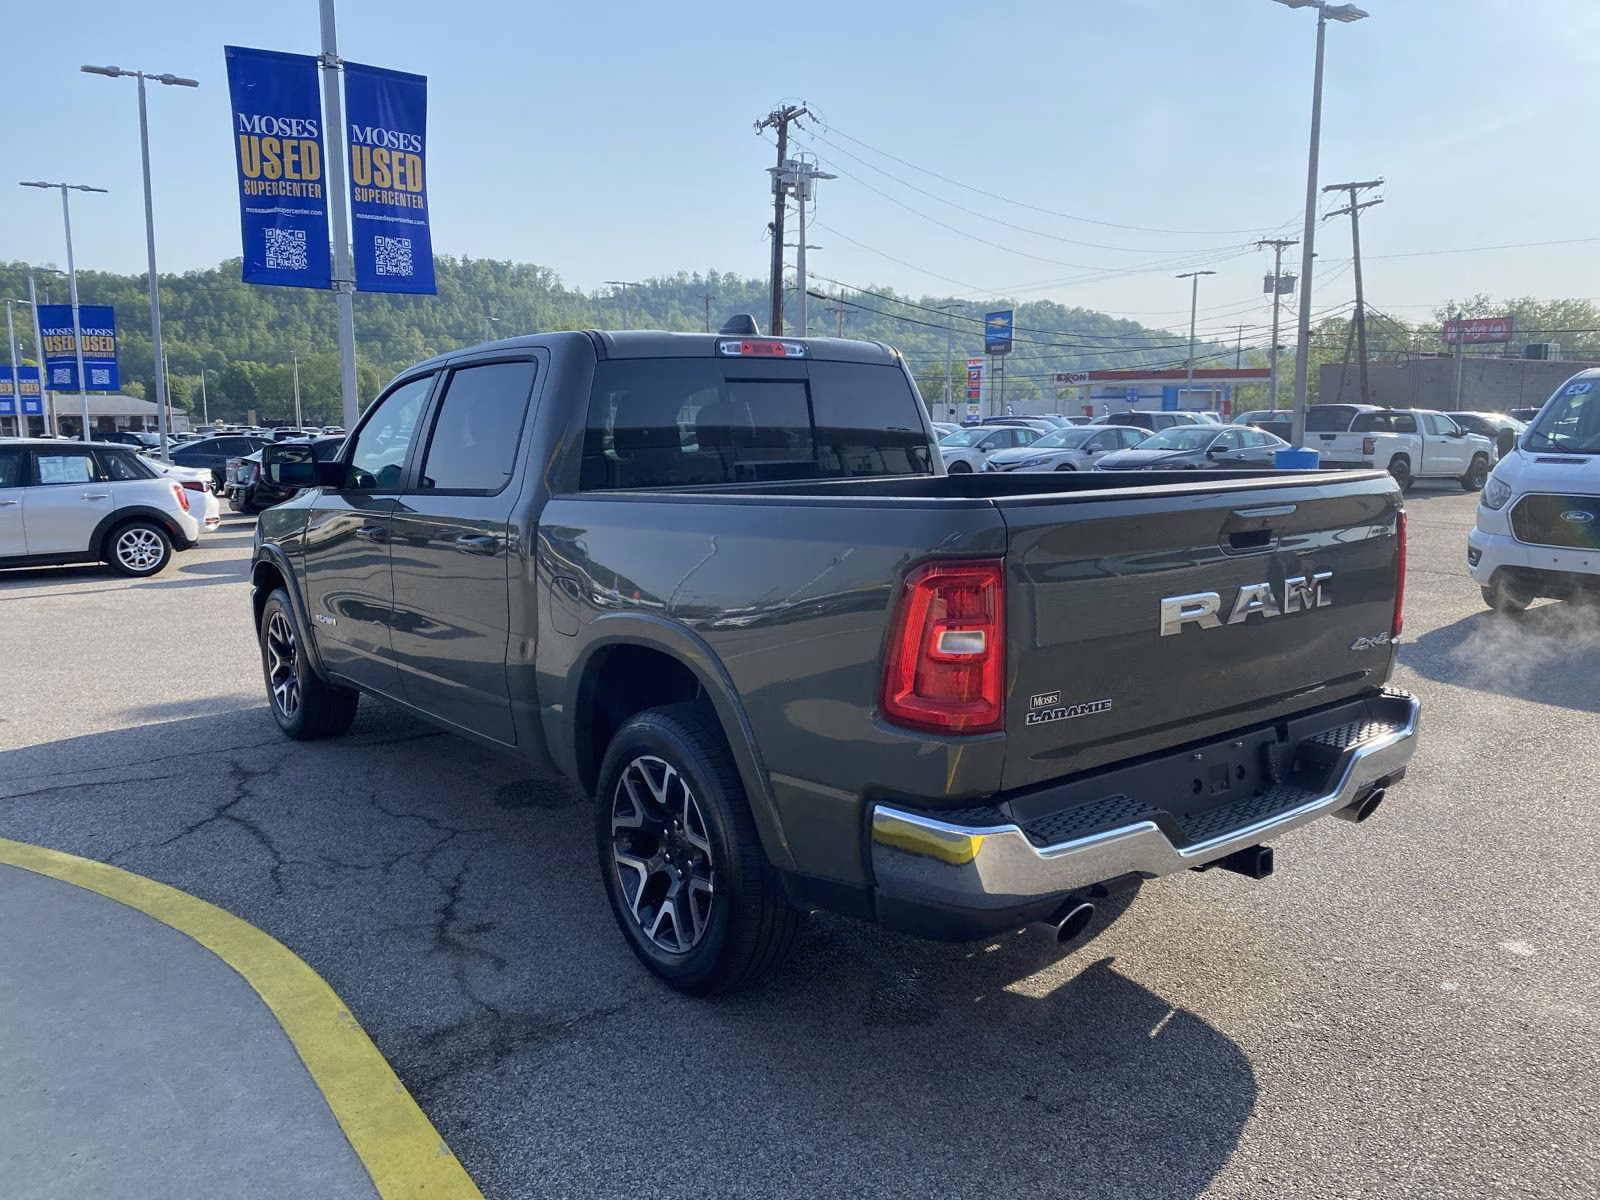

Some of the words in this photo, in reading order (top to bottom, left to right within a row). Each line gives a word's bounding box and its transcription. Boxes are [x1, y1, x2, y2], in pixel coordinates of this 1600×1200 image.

[238, 112, 319, 138] MOSES
[351, 124, 422, 153] MOSES
[239, 134, 321, 181] USED
[351, 145, 423, 193] USED
[244, 179, 322, 199] SUPERCENTER
[354, 187, 424, 209] SUPERCENTER
[245, 206, 323, 216] mosesusedsupercenter.com
[42, 327, 74, 336] MOSES
[81, 327, 114, 336] MOSES
[44, 336, 75, 351] USED
[82, 336, 114, 351] USED
[1056, 373, 1087, 384] EXXON
[1160, 571, 1333, 637] RAM
[1026, 698, 1112, 726] LARAMIE
